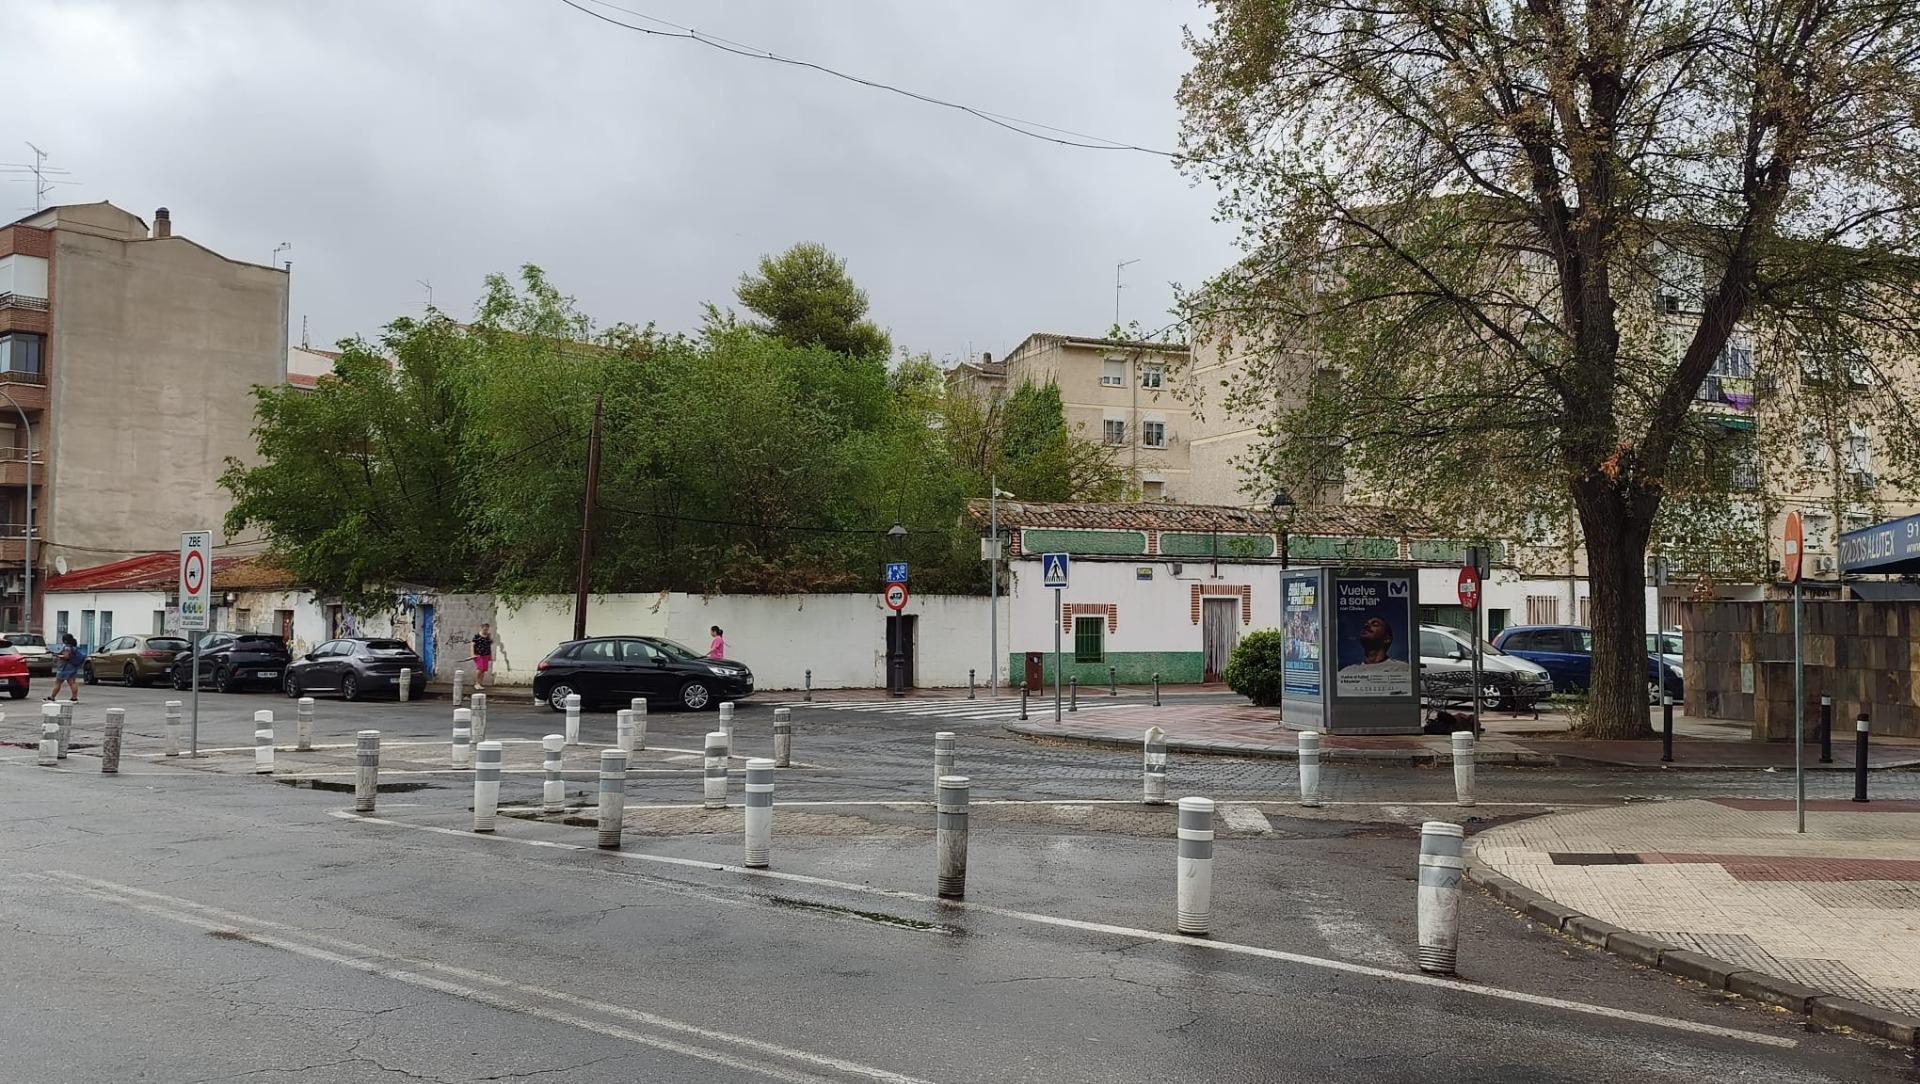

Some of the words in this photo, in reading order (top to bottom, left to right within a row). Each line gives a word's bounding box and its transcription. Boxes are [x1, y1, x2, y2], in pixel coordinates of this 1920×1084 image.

[188, 536, 201, 547] ZBE
[1867, 529, 1895, 560] ALUTEX
[1339, 584, 1376, 596] Vuelve
[1339, 597, 1347, 606] a
[1348, 595, 1380, 606] soñar
